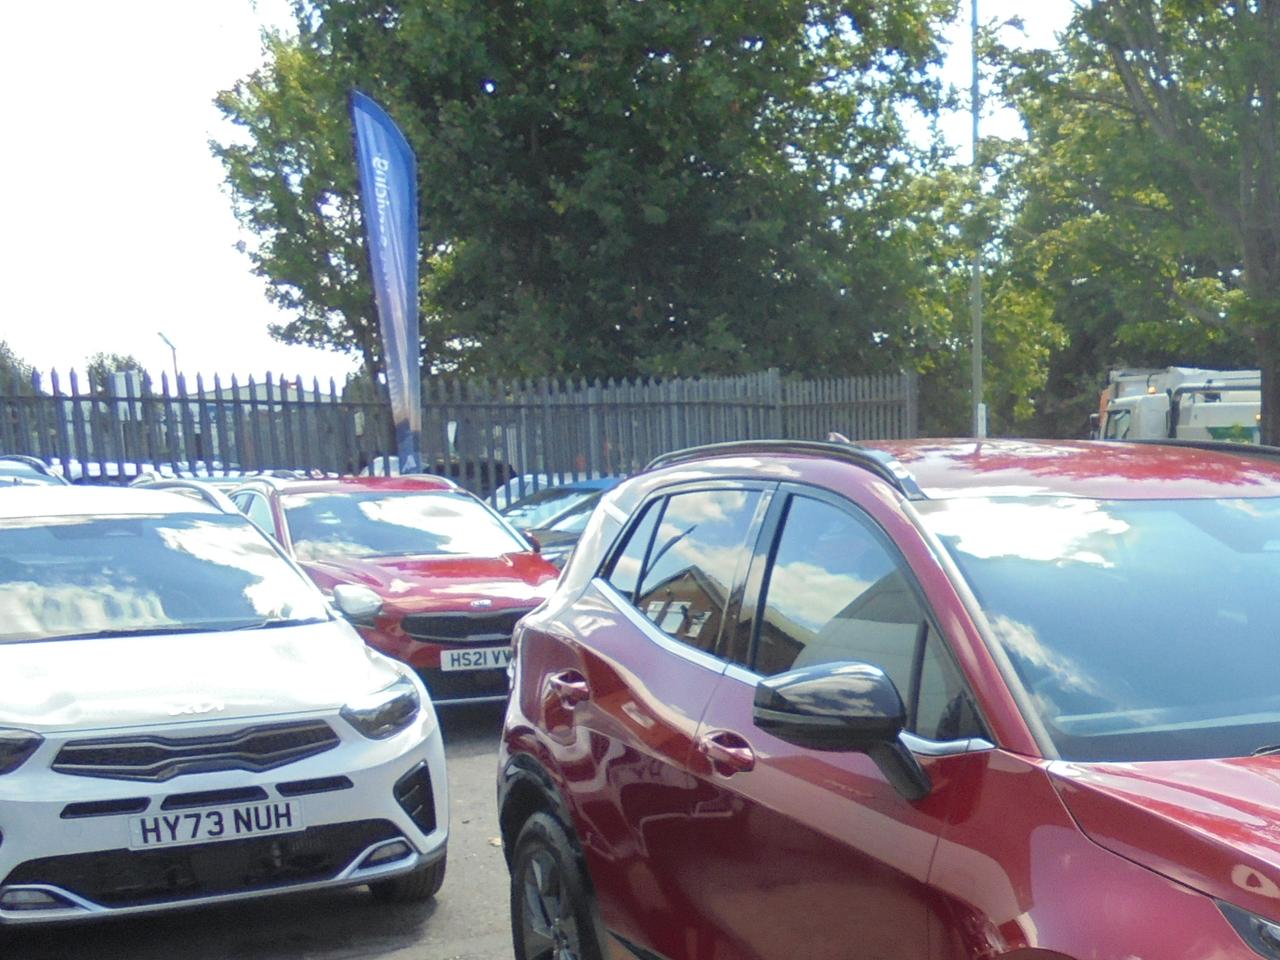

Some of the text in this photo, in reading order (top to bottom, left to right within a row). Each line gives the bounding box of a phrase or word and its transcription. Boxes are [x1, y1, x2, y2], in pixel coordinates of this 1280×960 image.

[450, 651, 487, 667] HS21
[140, 803, 293, 843] HY73 NUH
